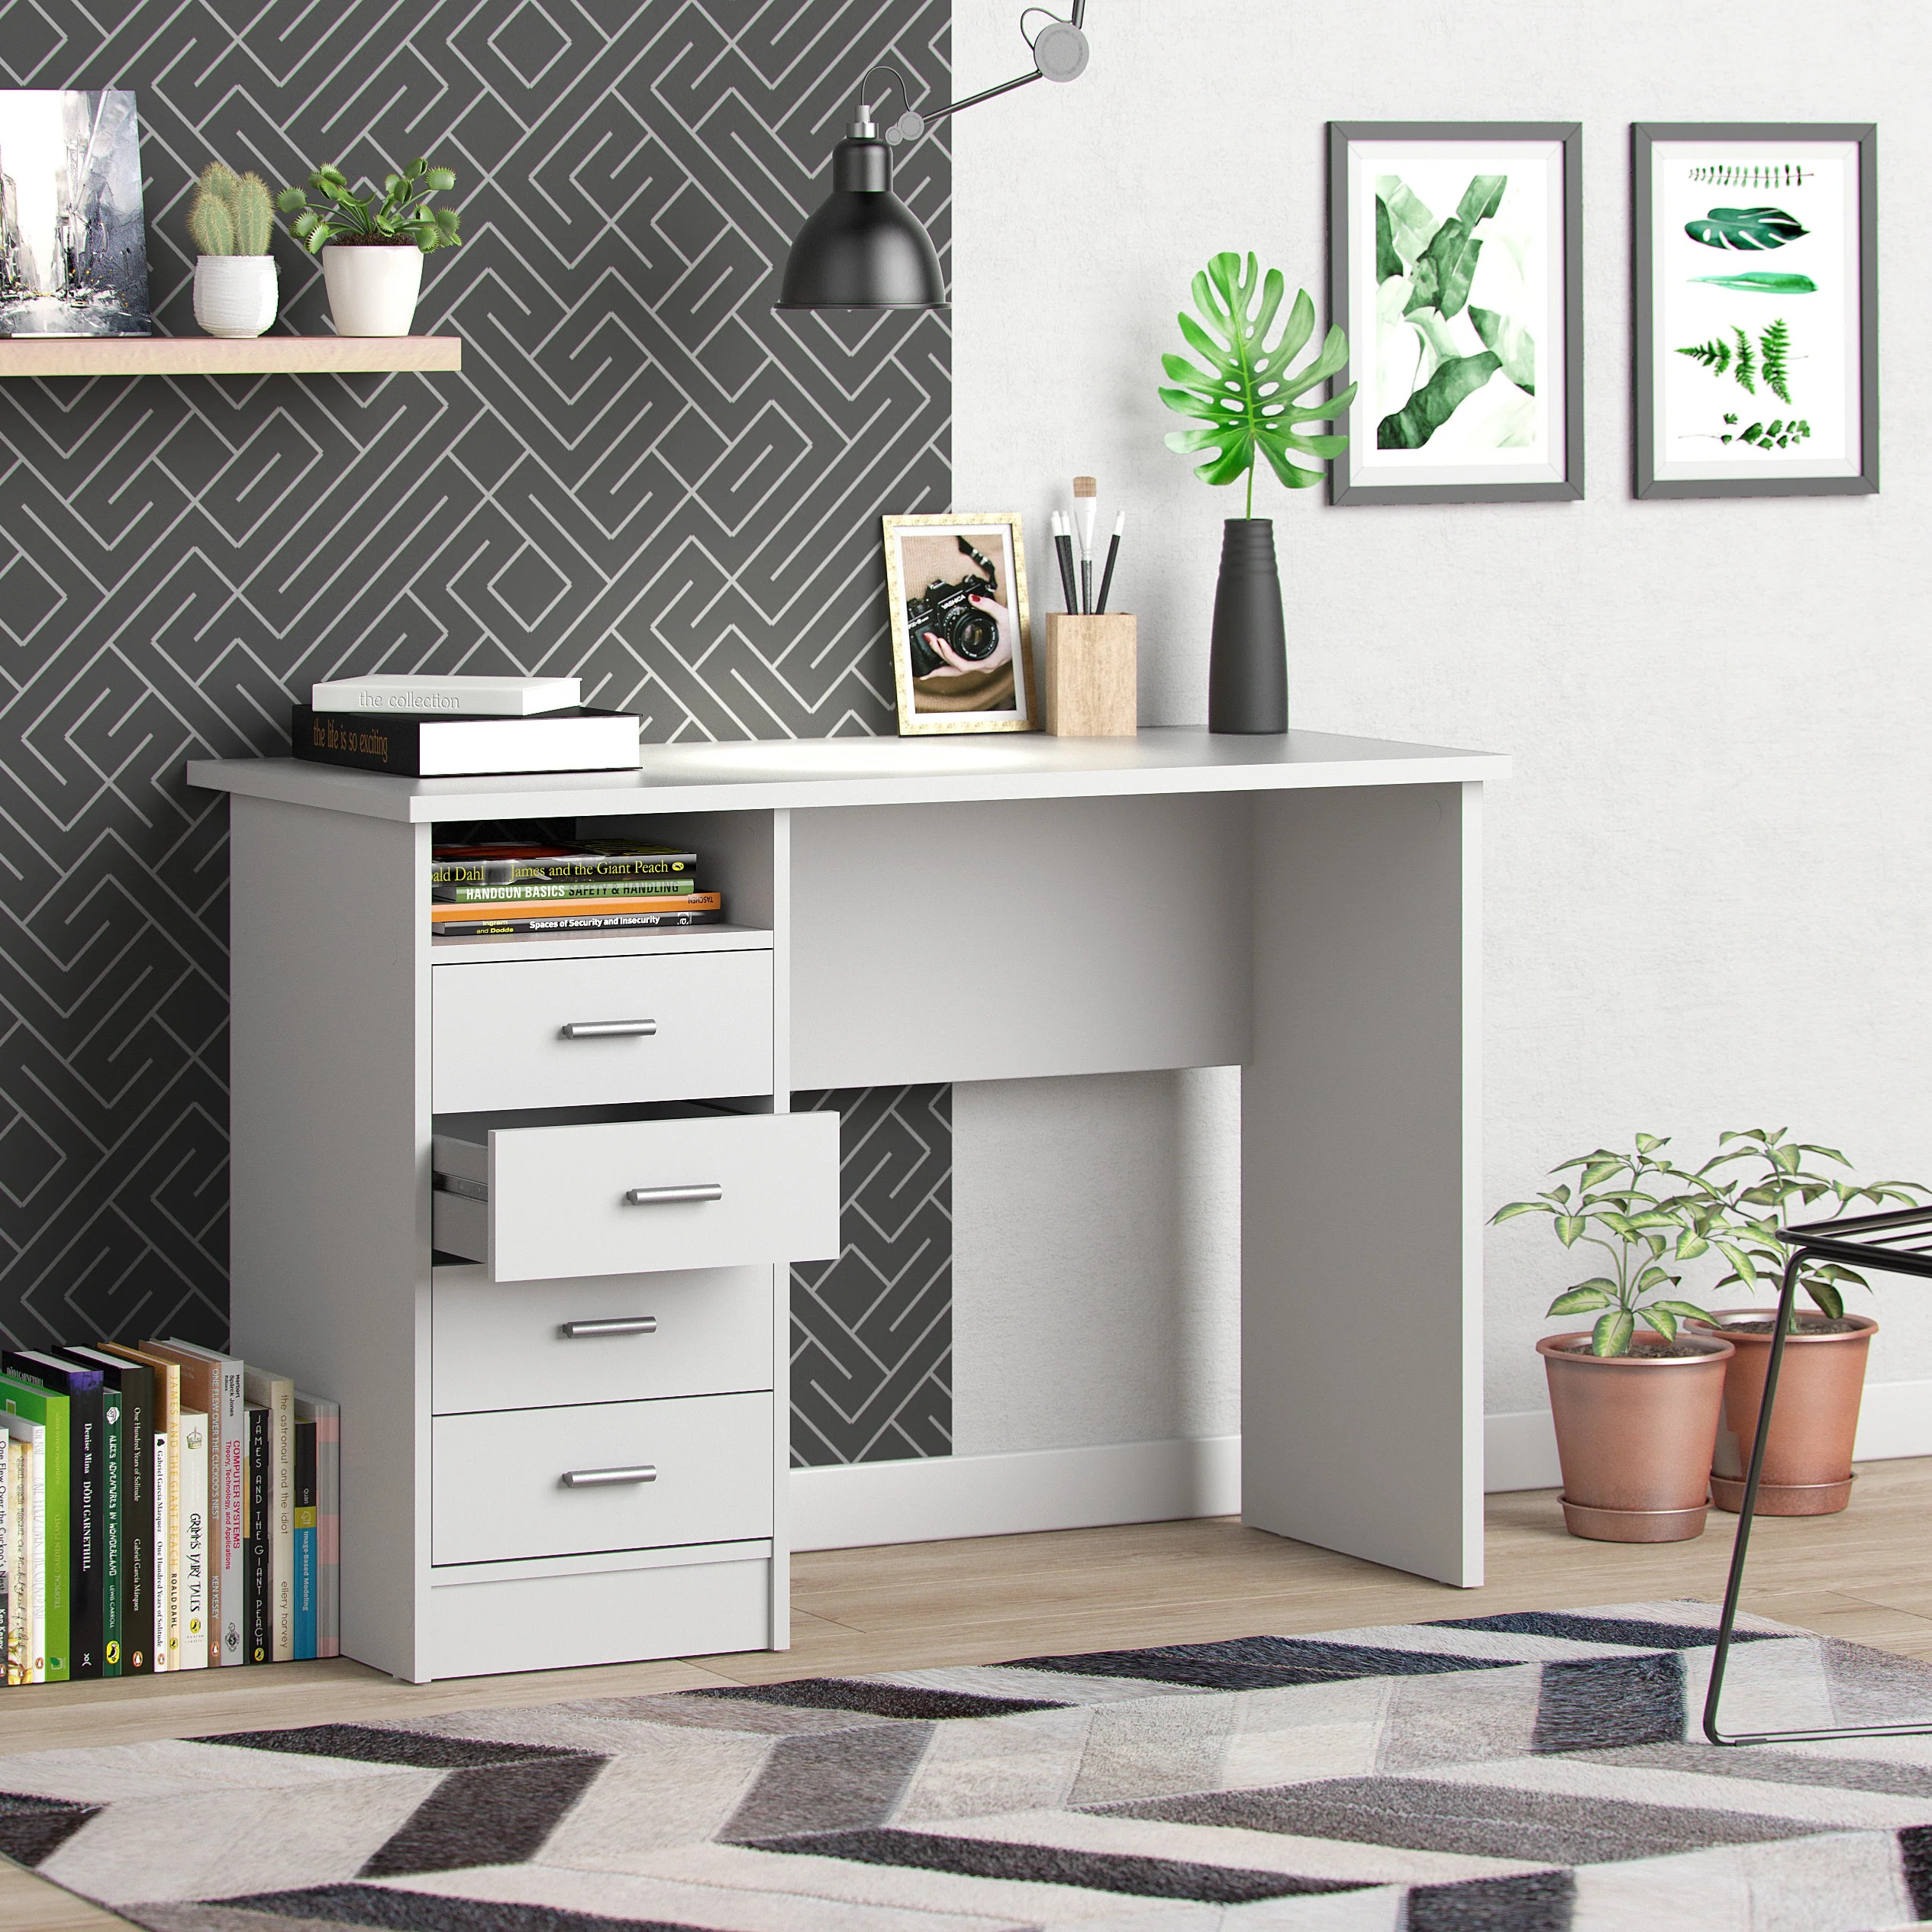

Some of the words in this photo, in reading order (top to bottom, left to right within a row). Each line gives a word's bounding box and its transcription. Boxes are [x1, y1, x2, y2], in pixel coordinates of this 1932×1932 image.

[358, 691, 382, 708] the
[388, 692, 460, 709] collection
[314, 718, 325, 747] the
[327, 719, 338, 749] life
[340, 725, 347, 750] is
[349, 732, 357, 752] so
[360, 728, 388, 763] exciting
[431, 866, 450, 882] ald
[455, 866, 485, 881] Dahl
[509, 864, 545, 882] James
[549, 863, 571, 876] and
[575, 862, 593, 876] the
[597, 861, 631, 875] Giant
[634, 860, 669, 873] Peach
[466, 886, 521, 900] HANDGUN
[525, 885, 565, 898] BASICS
[569, 883, 608, 896] SAFETY
[611, 884, 619, 895] &
[623, 881, 679, 895] HANDLING
[530, 920, 558, 930] Spaces
[569, 918, 602, 928] Security
[603, 917, 619, 925] and
[620, 915, 660, 926] Insecurity
[169, 1376, 178, 1416] JAMES
[280, 1394, 289, 1410] the
[169, 1422, 178, 1448] AND
[254, 1414, 263, 1468] JAMES
[280, 1414, 289, 1463] astronaut
[169, 1453, 178, 1476] THE
[280, 1469, 289, 1488] and
[169, 1482, 178, 1519] GIANT
[254, 1475, 263, 1504] AND
[280, 1493, 289, 1508] the
[109, 1511, 117, 1520] IN
[254, 1511, 263, 1540] THE
[280, 1512, 289, 1534] idiot
[83, 1509, 92, 1572] GARNETHILL
[169, 1526, 178, 1566] PEACH
[254, 1545, 264, 1595] GIANT
[280, 1582, 289, 1609] ellery
[254, 1600, 263, 1646] PEACH
[280, 1613, 289, 1648] harvey
